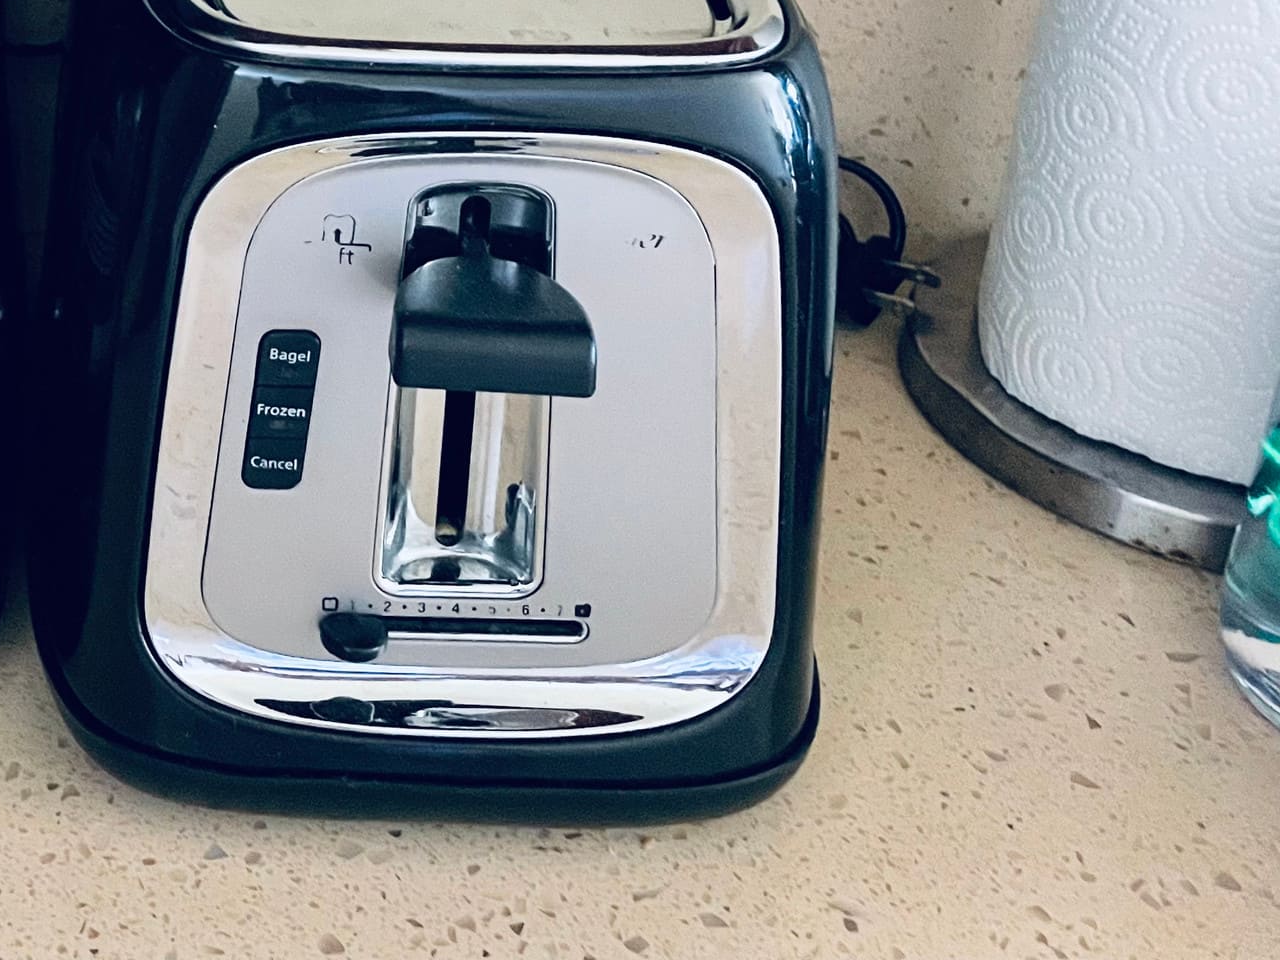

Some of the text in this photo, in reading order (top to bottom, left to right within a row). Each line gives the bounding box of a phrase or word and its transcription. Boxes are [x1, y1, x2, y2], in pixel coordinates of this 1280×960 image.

[269, 348, 311, 364] Bagel
[256, 403, 306, 418] Frozen
[250, 456, 298, 471] Cancel
[383, 601, 392, 612] 2
[417, 602, 426, 613] 3
[451, 603, 460, 613] 4
[521, 604, 530, 616] 6
